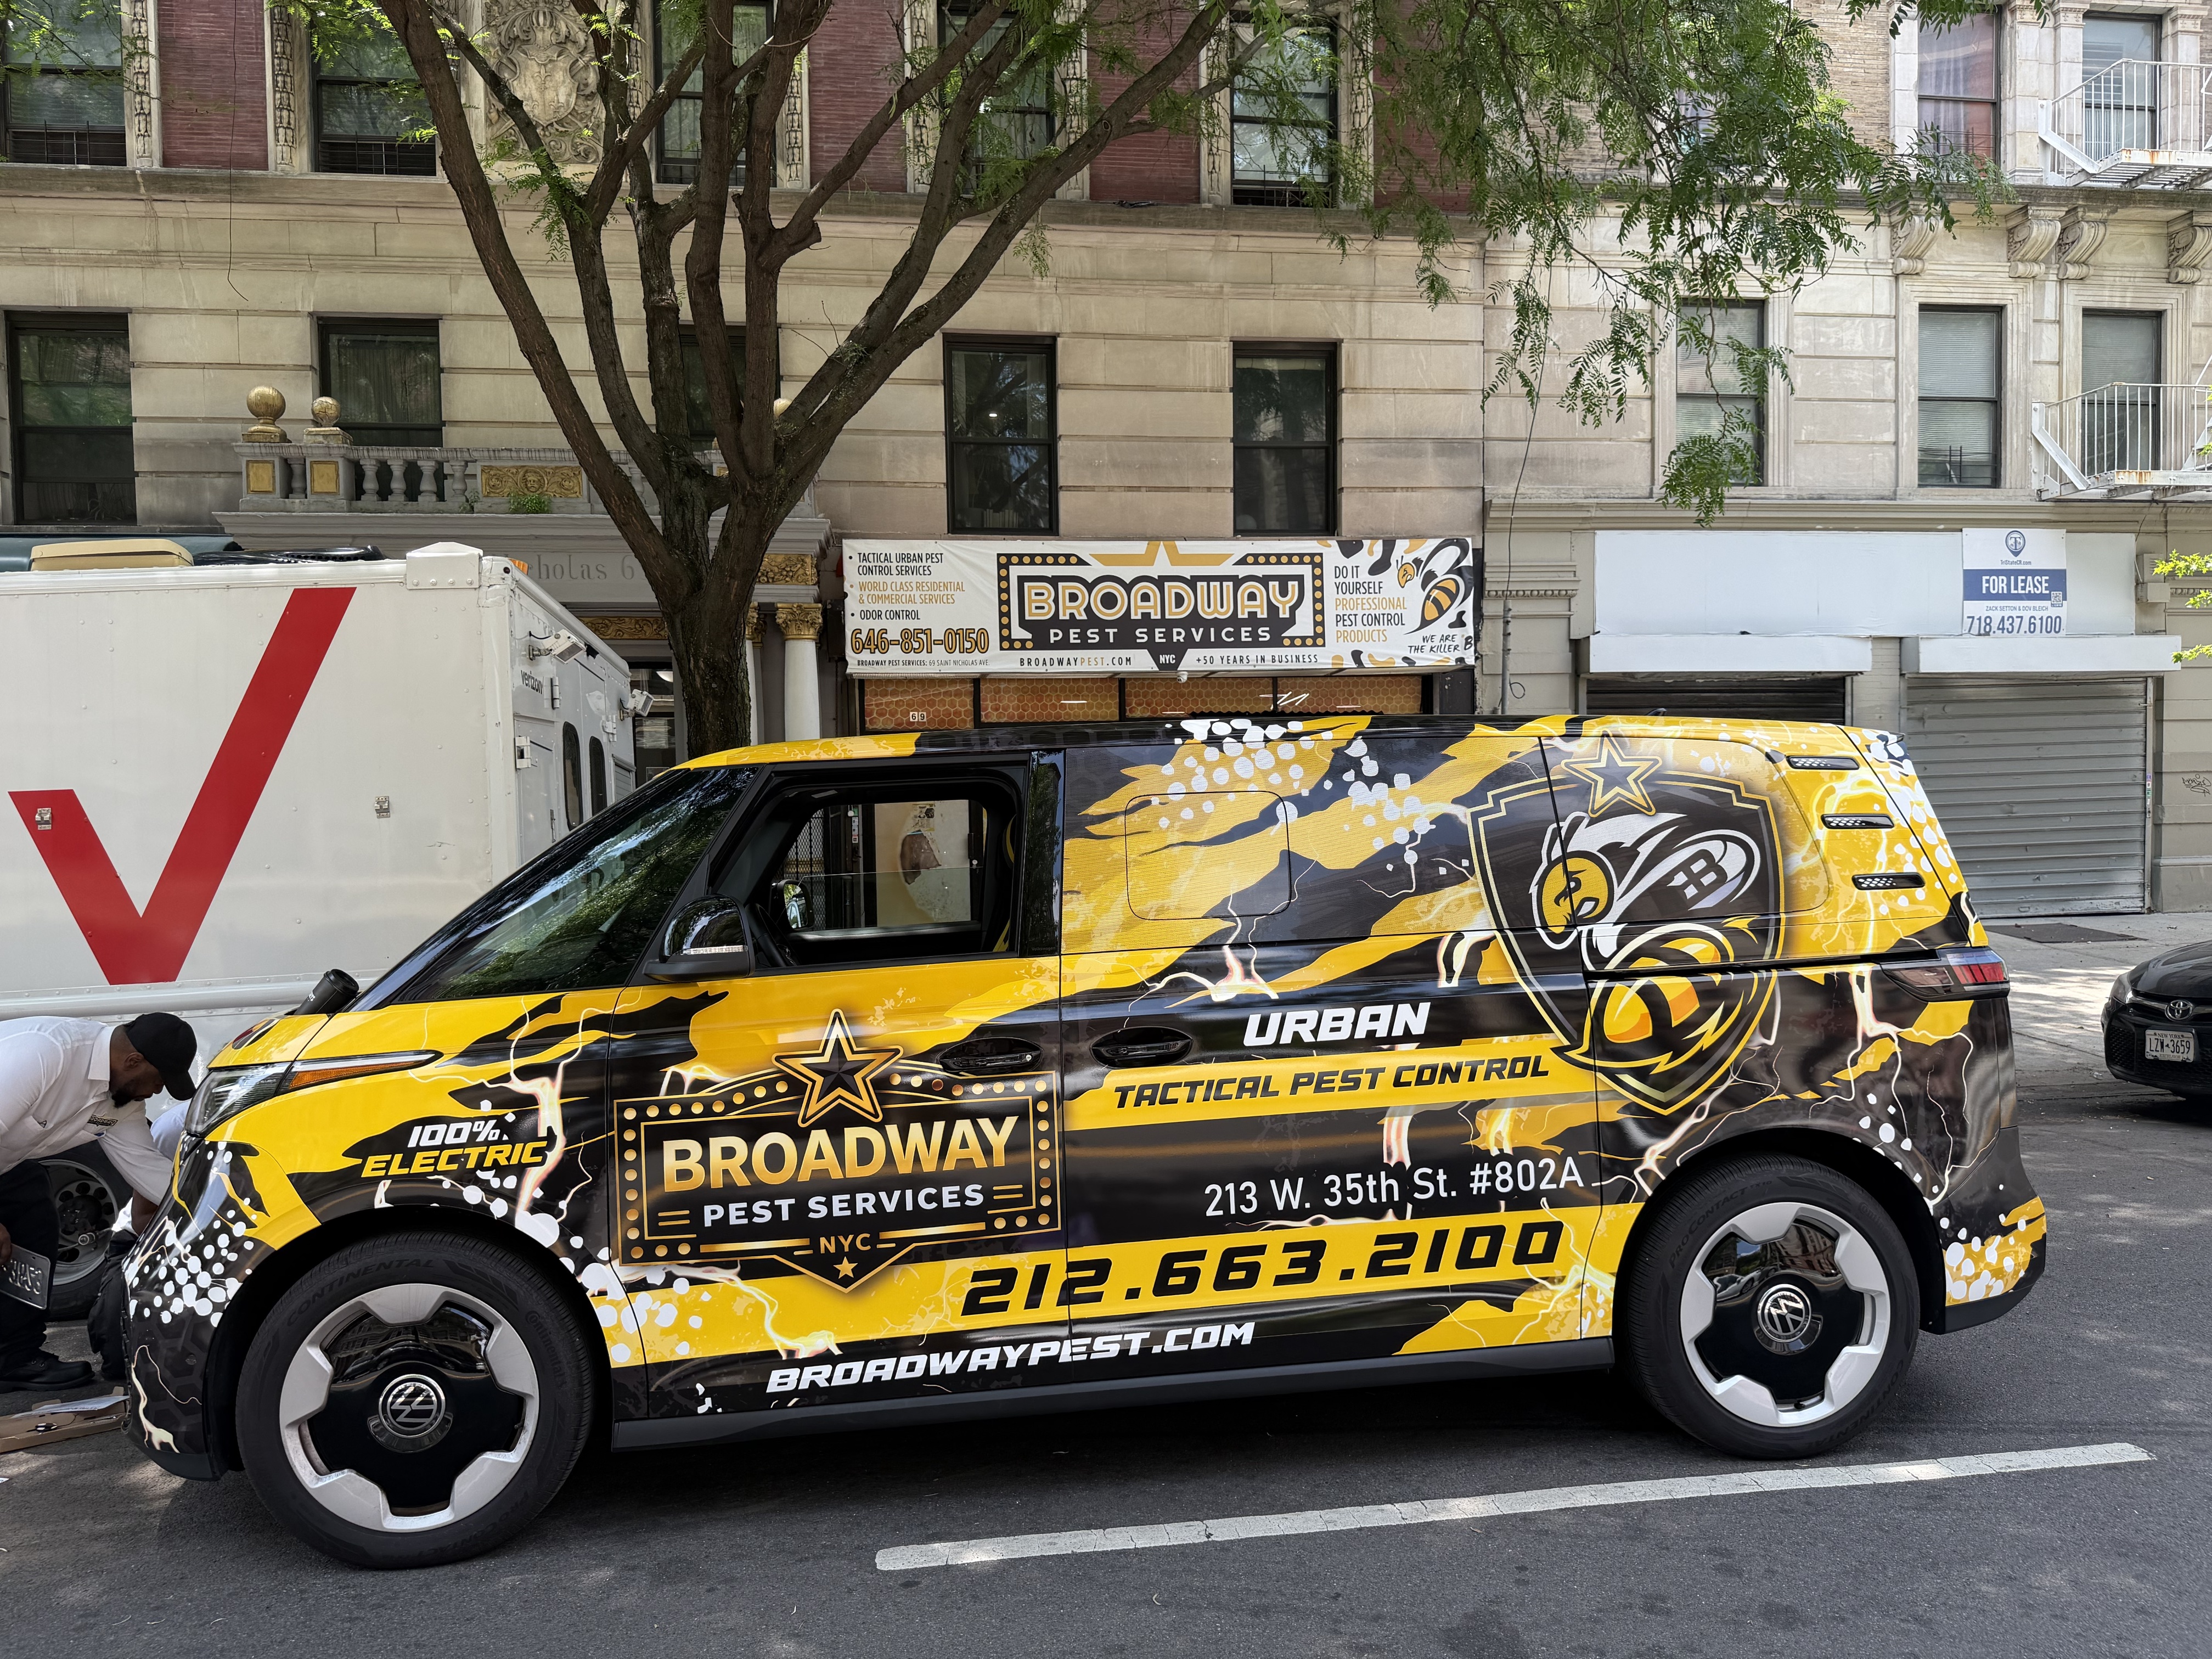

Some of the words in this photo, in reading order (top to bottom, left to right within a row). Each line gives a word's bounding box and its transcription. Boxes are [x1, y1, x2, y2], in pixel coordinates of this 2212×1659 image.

[528, 554, 607, 580] holas
[858, 553, 893, 563] TACTICAL
[896, 553, 923, 563] URBAN
[925, 553, 944, 563] PEST
[858, 565, 893, 576] CONTROL
[896, 565, 932, 576] SERVICES
[1334, 566, 1348, 578] DO
[1352, 566, 1360, 578] IT
[859, 581, 888, 592] WORLD
[890, 581, 914, 592] CLASS
[916, 581, 965, 592] RESIDENTIAL
[1334, 581, 1383, 595] YOURSELF
[1982, 576, 2007, 594] FOR
[2011, 576, 2050, 594] LEASE
[859, 594, 865, 604] &
[867, 594, 917, 604] COMMERCIAL
[919, 594, 955, 604] SERVICES
[1024, 581, 1299, 621] BROADWAY
[1335, 597, 1407, 611] PROFESSIONAL
[860, 610, 882, 620] ODOR
[885, 610, 920, 620] CONTROL
[1336, 614, 1358, 627] PEST
[1361, 612, 1405, 626] CONTROL
[1967, 615, 2062, 634] 718.437.6100
[851, 628, 989, 654] 646-851-0150
[1049, 628, 1118, 644] PEST
[1135, 626, 1271, 643] SERVICES
[1336, 629, 1387, 643] PRODUCTS
[1422, 634, 1437, 643] WE
[1439, 634, 1457, 643] ARE
[1408, 645, 1426, 654] THE
[1429, 644, 1460, 654] KILLER
[1020, 656, 1132, 667] BROADWAYPEST.COM
[1159, 654, 1176, 664] NYC
[1196, 655, 1214, 665] +50
[1220, 655, 1251, 665] YEARS
[1256, 655, 1265, 664] IN
[1271, 654, 1318, 663] BUSINESS
[521, 670, 542, 695] verizon
[1243, 1002, 1431, 1047] URBAN
[1114, 1075, 1280, 1109] TACTICAL
[1290, 1065, 1386, 1096] PEST
[1393, 1055, 1550, 1088] CONTROL
[361, 1140, 548, 1178] ELECTRIC
[662, 1116, 1020, 1193] BROADWAY
[1204, 1180, 1259, 1217] 213
[1270, 1176, 1311, 1210] W.
[1323, 1170, 1401, 1207] 35th
[1413, 1166, 1457, 1200] St.
[1468, 1156, 1584, 1195] #802A
[703, 1197, 796, 1228] PEST
[807, 1183, 986, 1219] SERVICES
[820, 1232, 871, 1255] NYC
[960, 1220, 1564, 1317] 212.663.2100
[285, 1259, 435, 1326] CONTINENTAL
[766, 1321, 1256, 1394] BROADWAYPEST.COM
